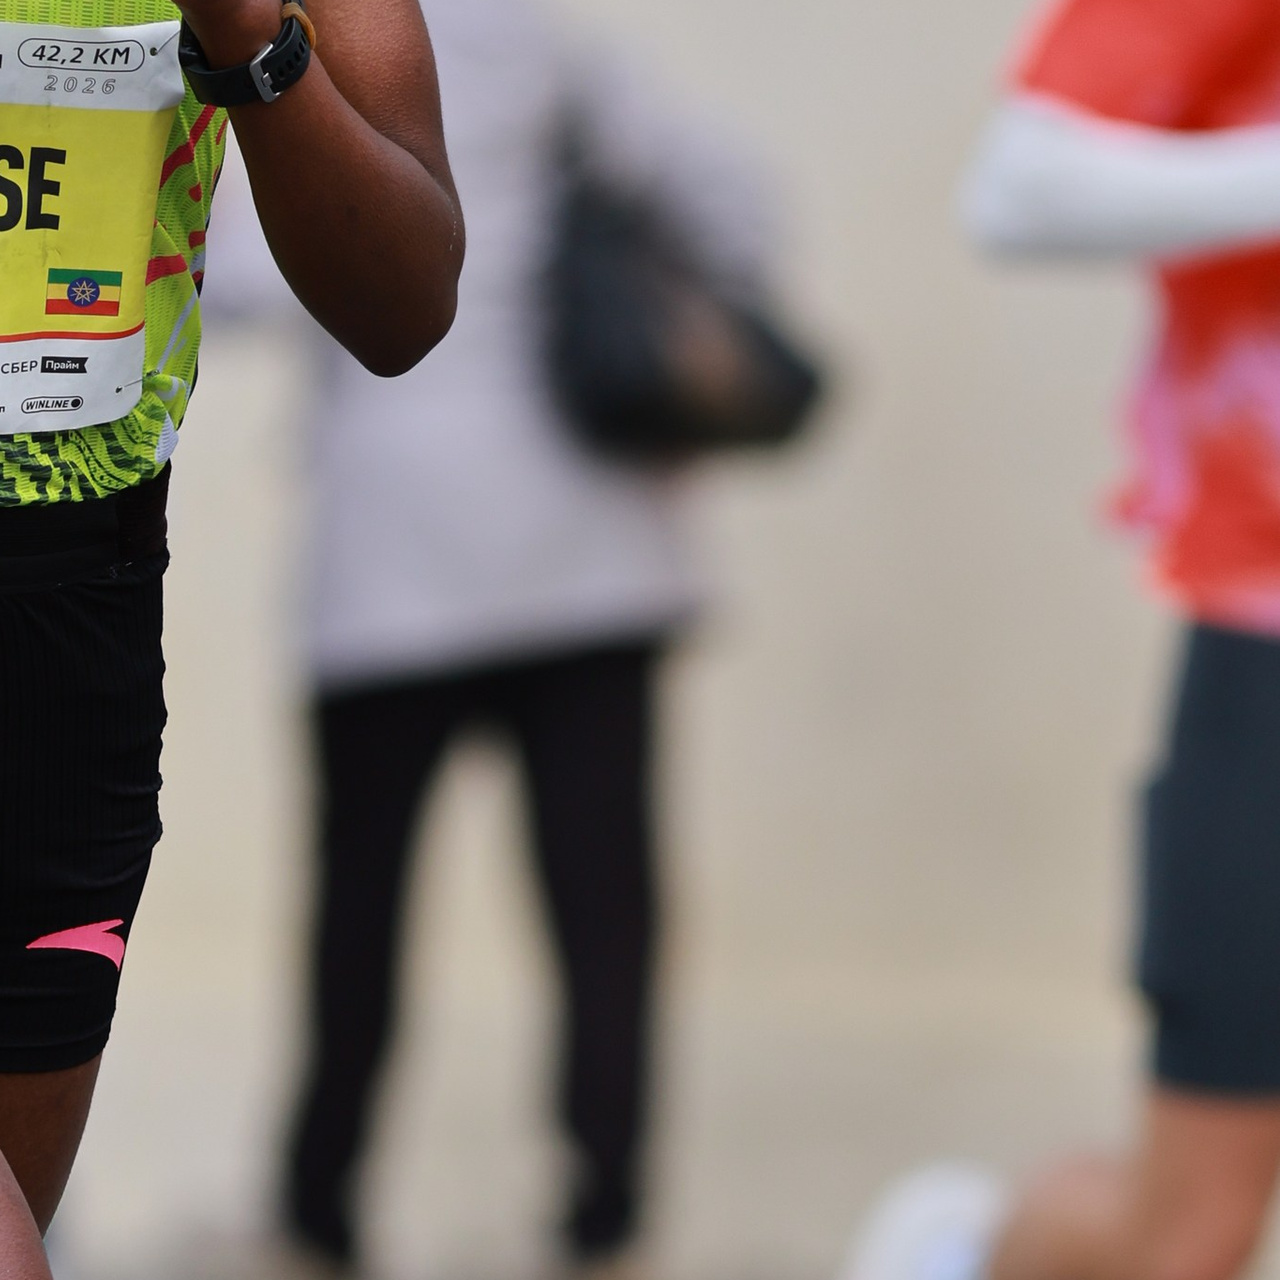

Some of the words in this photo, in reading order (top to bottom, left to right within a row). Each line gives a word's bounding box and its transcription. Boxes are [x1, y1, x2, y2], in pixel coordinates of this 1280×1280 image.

[32, 45, 84, 65] 42,2
[44, 75, 116, 94] 2026
[0, 360, 38, 374] СБЕР
[45, 360, 80, 370] Прайм
[25, 400, 70, 410] WINLINE
